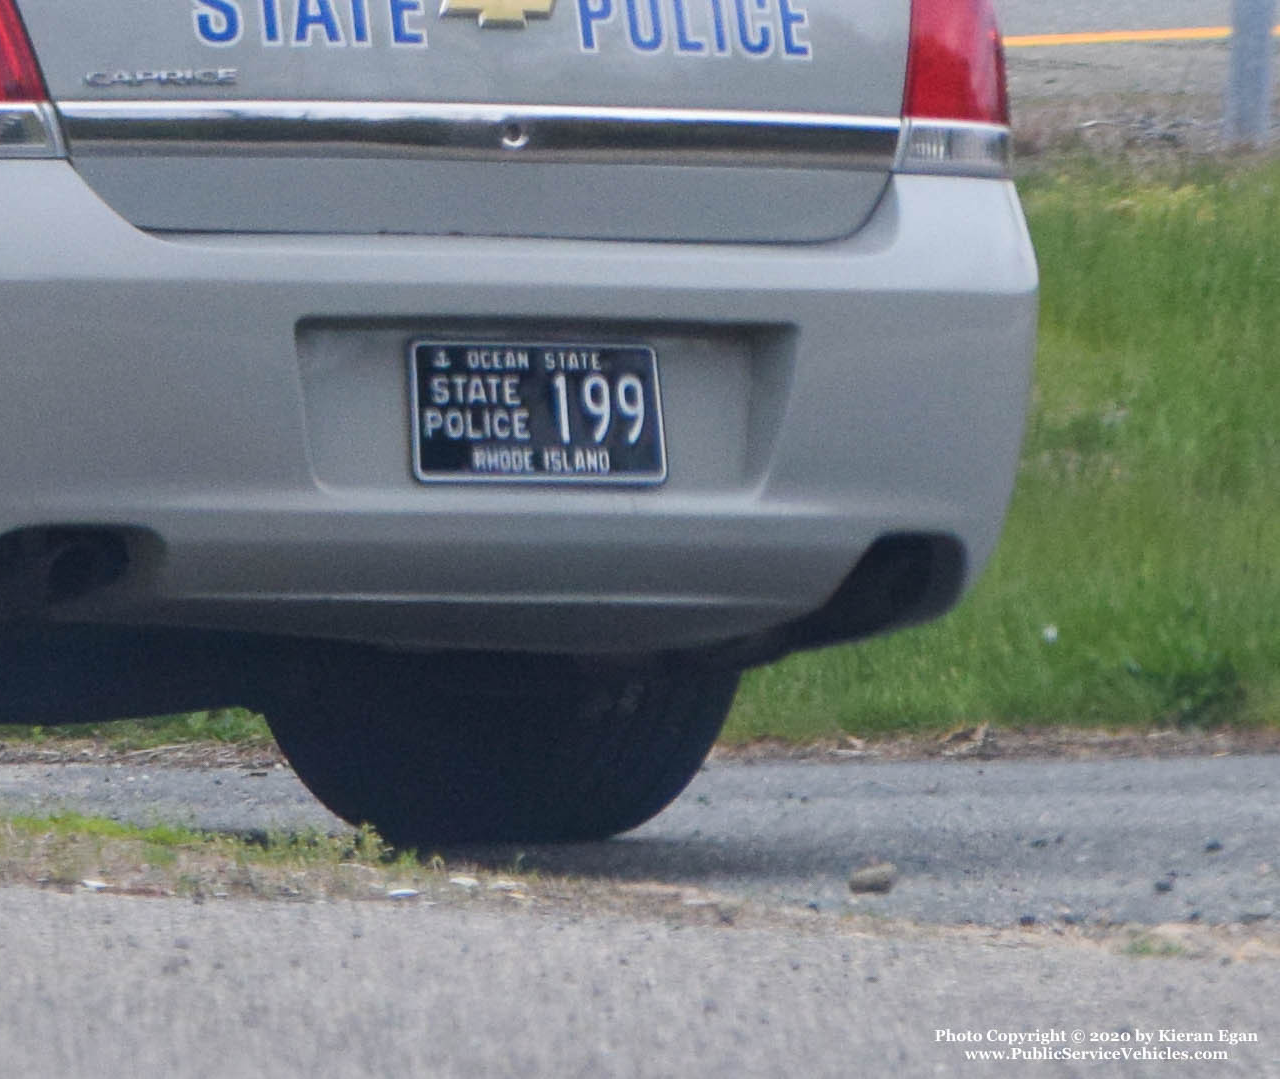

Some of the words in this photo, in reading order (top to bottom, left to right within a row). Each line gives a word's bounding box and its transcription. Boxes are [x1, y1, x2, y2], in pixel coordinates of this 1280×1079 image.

[82, 68, 237, 87] CAPRICE
[467, 351, 530, 370] OCEAN
[544, 351, 602, 370] STATE
[430, 374, 521, 406] STATE
[553, 374, 645, 444] 199
[423, 408, 531, 440] POLICE
[472, 447, 534, 471] RHODE
[543, 448, 610, 471] ISLAND
